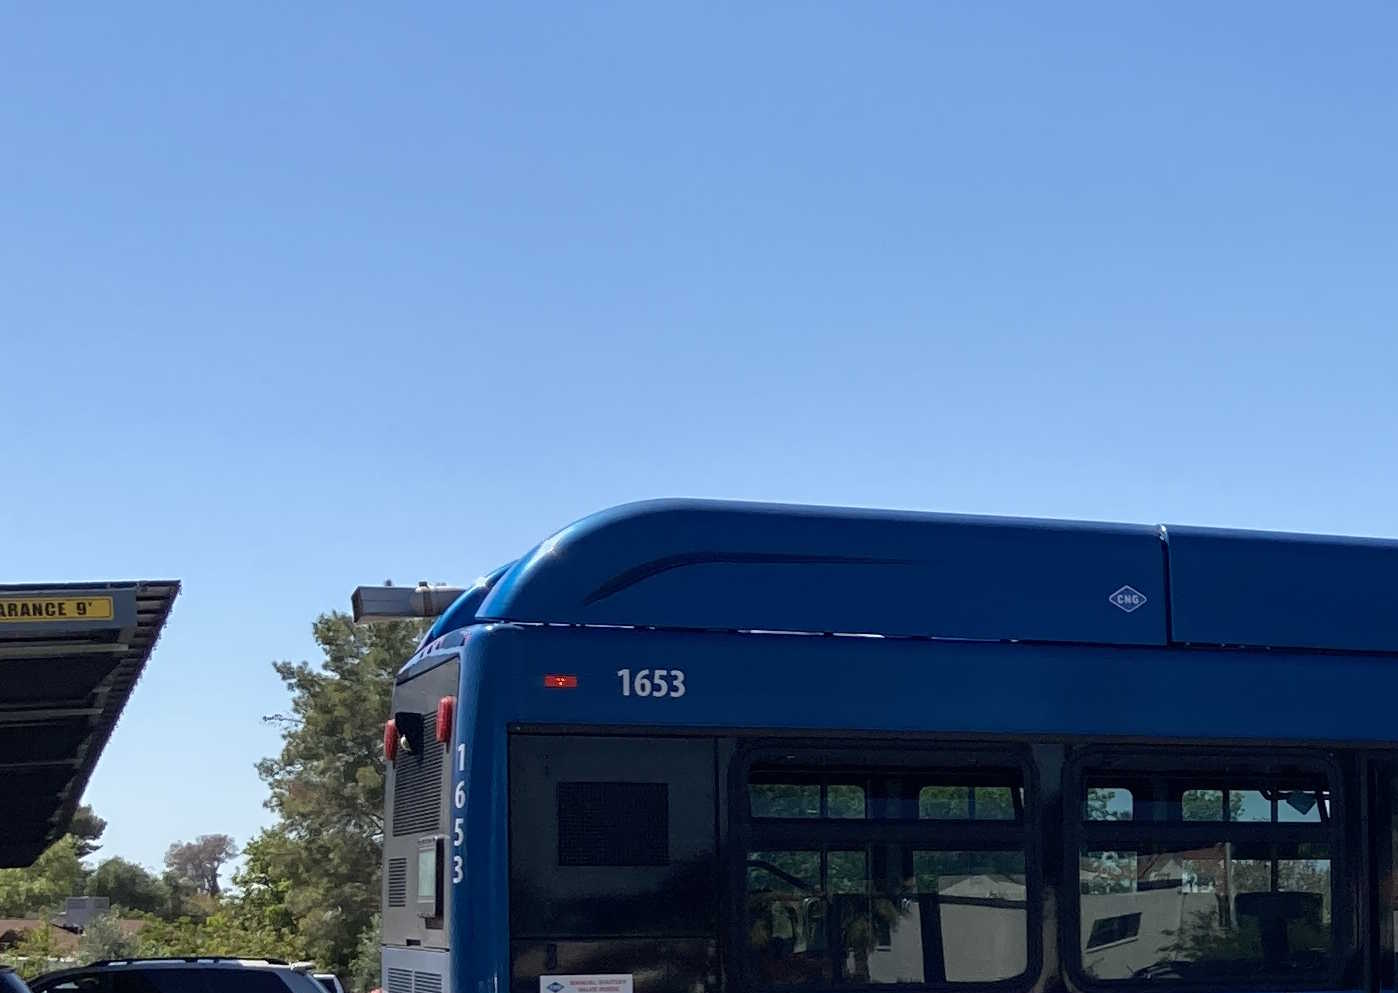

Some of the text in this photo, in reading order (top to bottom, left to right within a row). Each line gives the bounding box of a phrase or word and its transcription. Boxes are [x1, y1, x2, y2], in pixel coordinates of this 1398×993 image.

[1117, 594, 1140, 605] CNG
[616, 668, 687, 698] 1653
[452, 743, 467, 884] 1653
